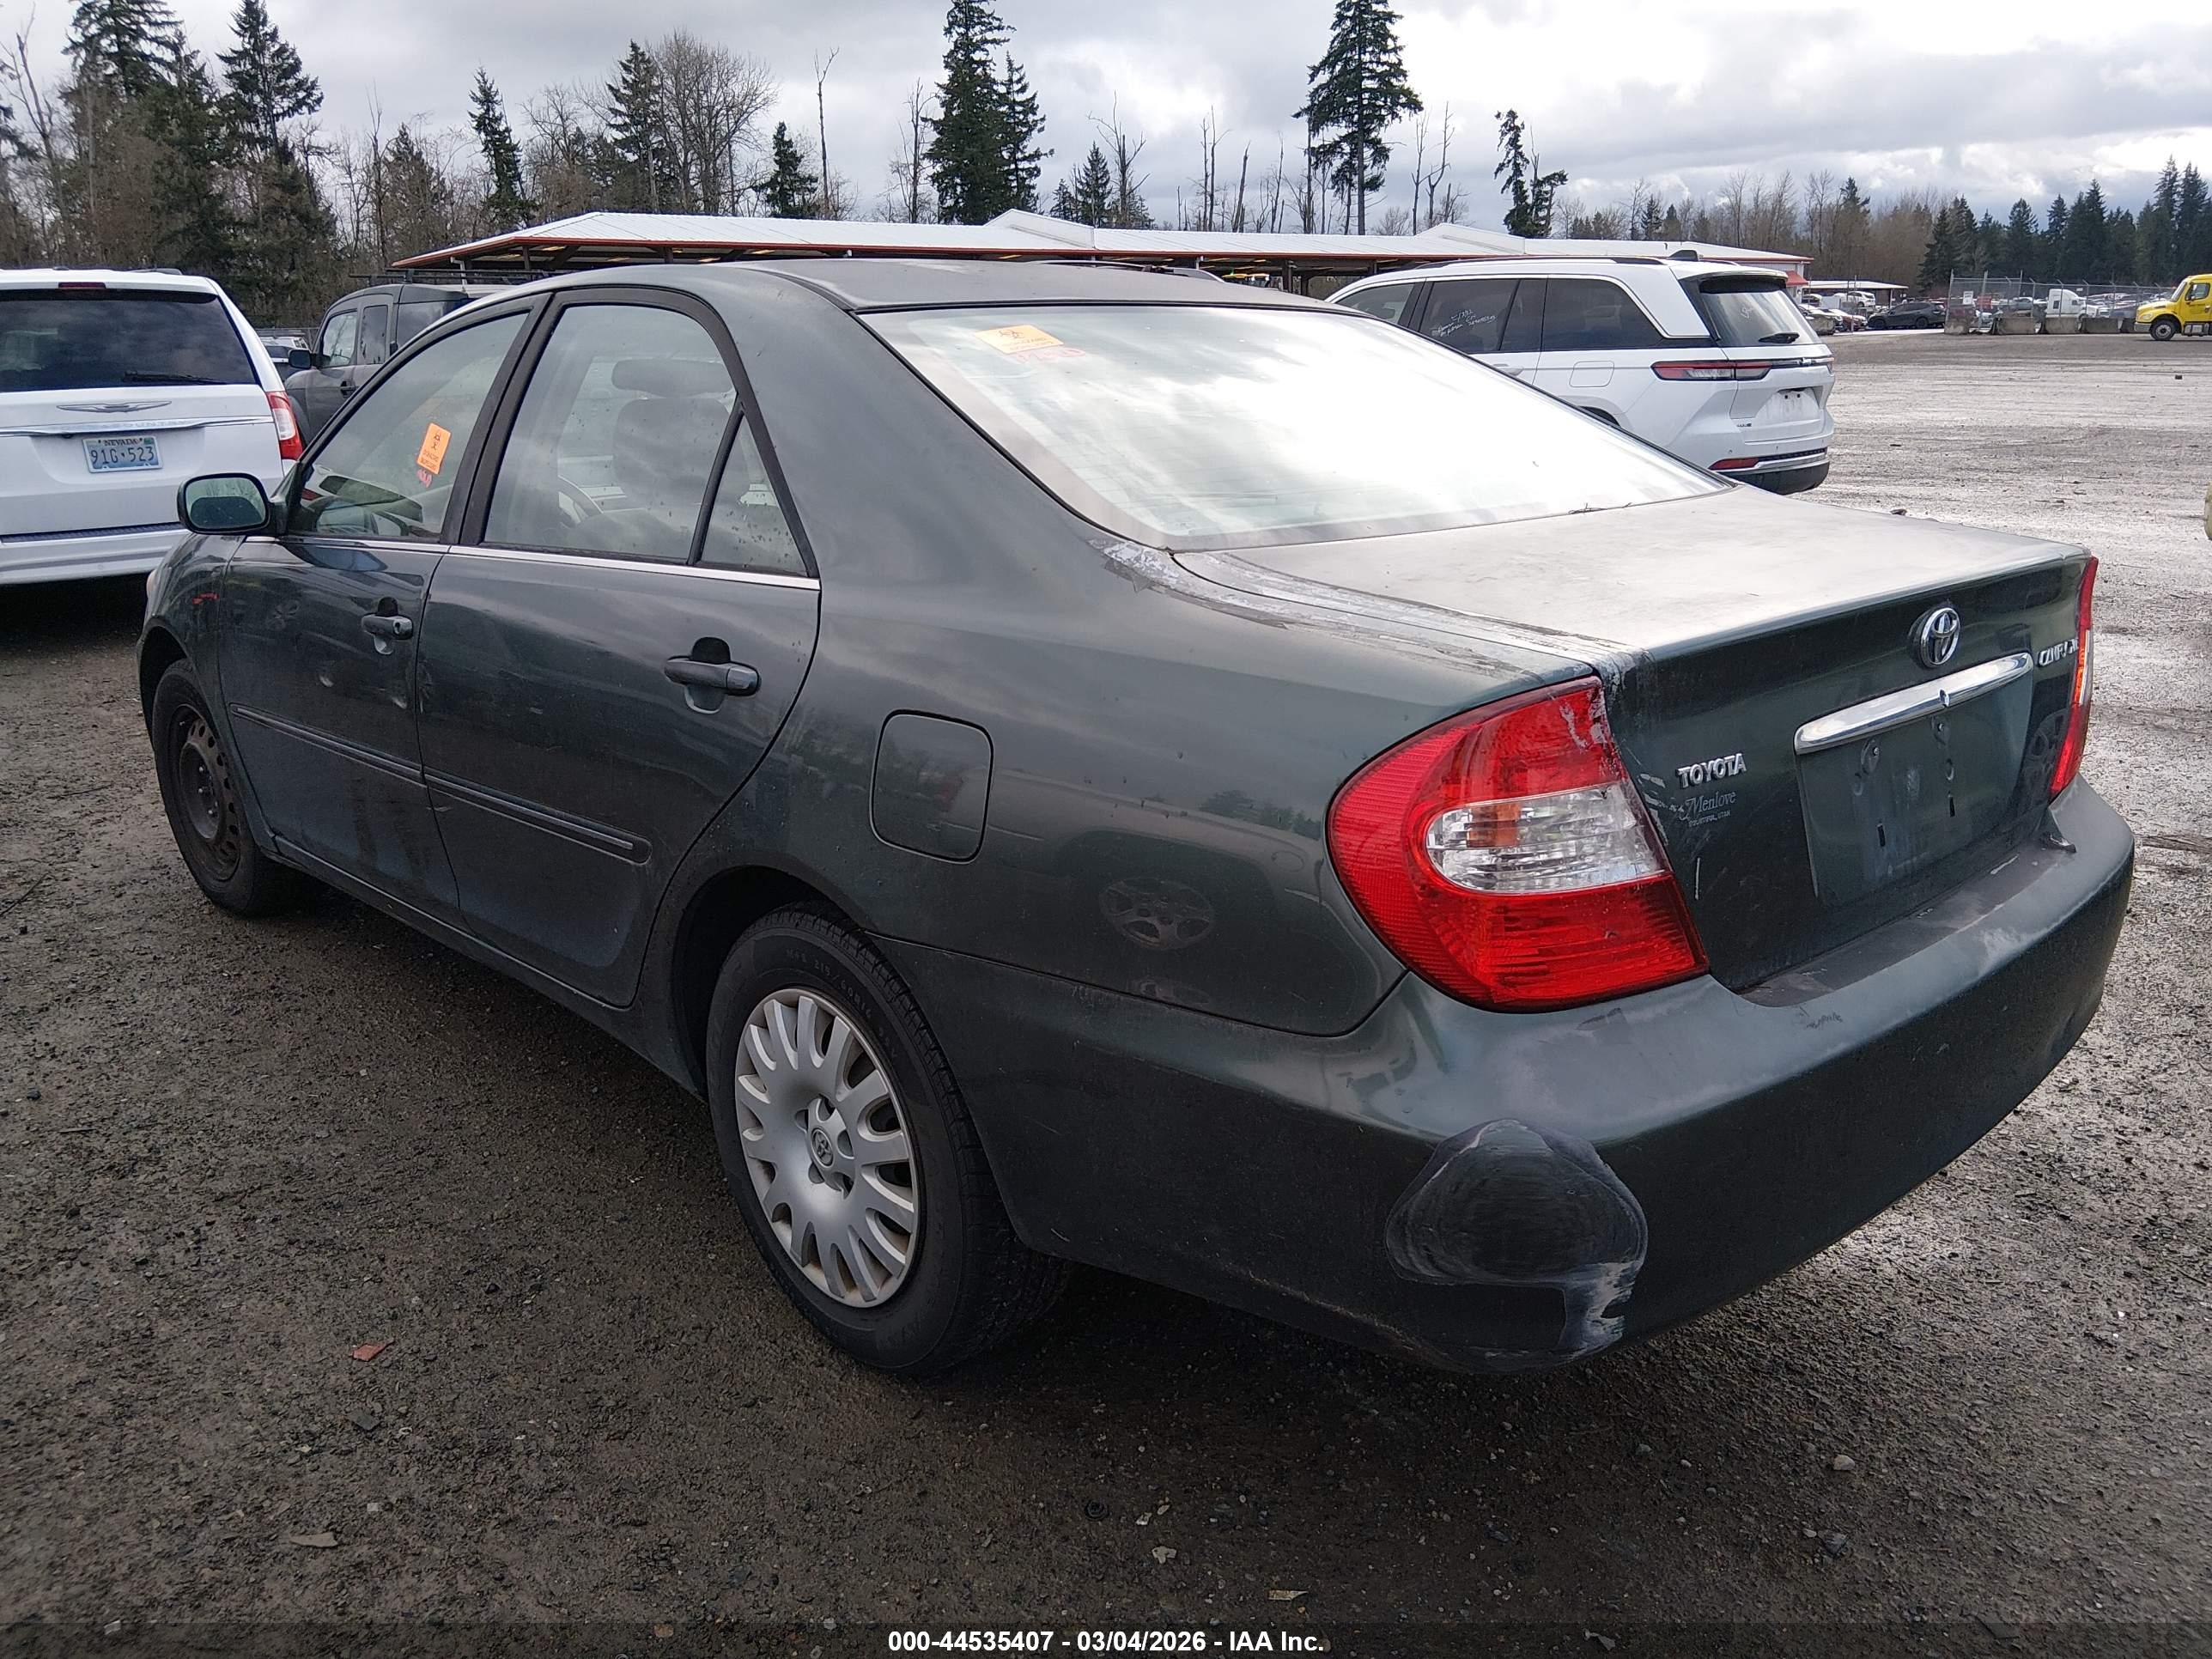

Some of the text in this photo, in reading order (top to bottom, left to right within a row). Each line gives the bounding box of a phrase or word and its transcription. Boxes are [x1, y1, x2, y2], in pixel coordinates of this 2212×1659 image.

[103, 438, 139, 447] NEVADA
[1676, 752, 1747, 788] TOYOTA
[1680, 791, 1736, 821] Menlove
